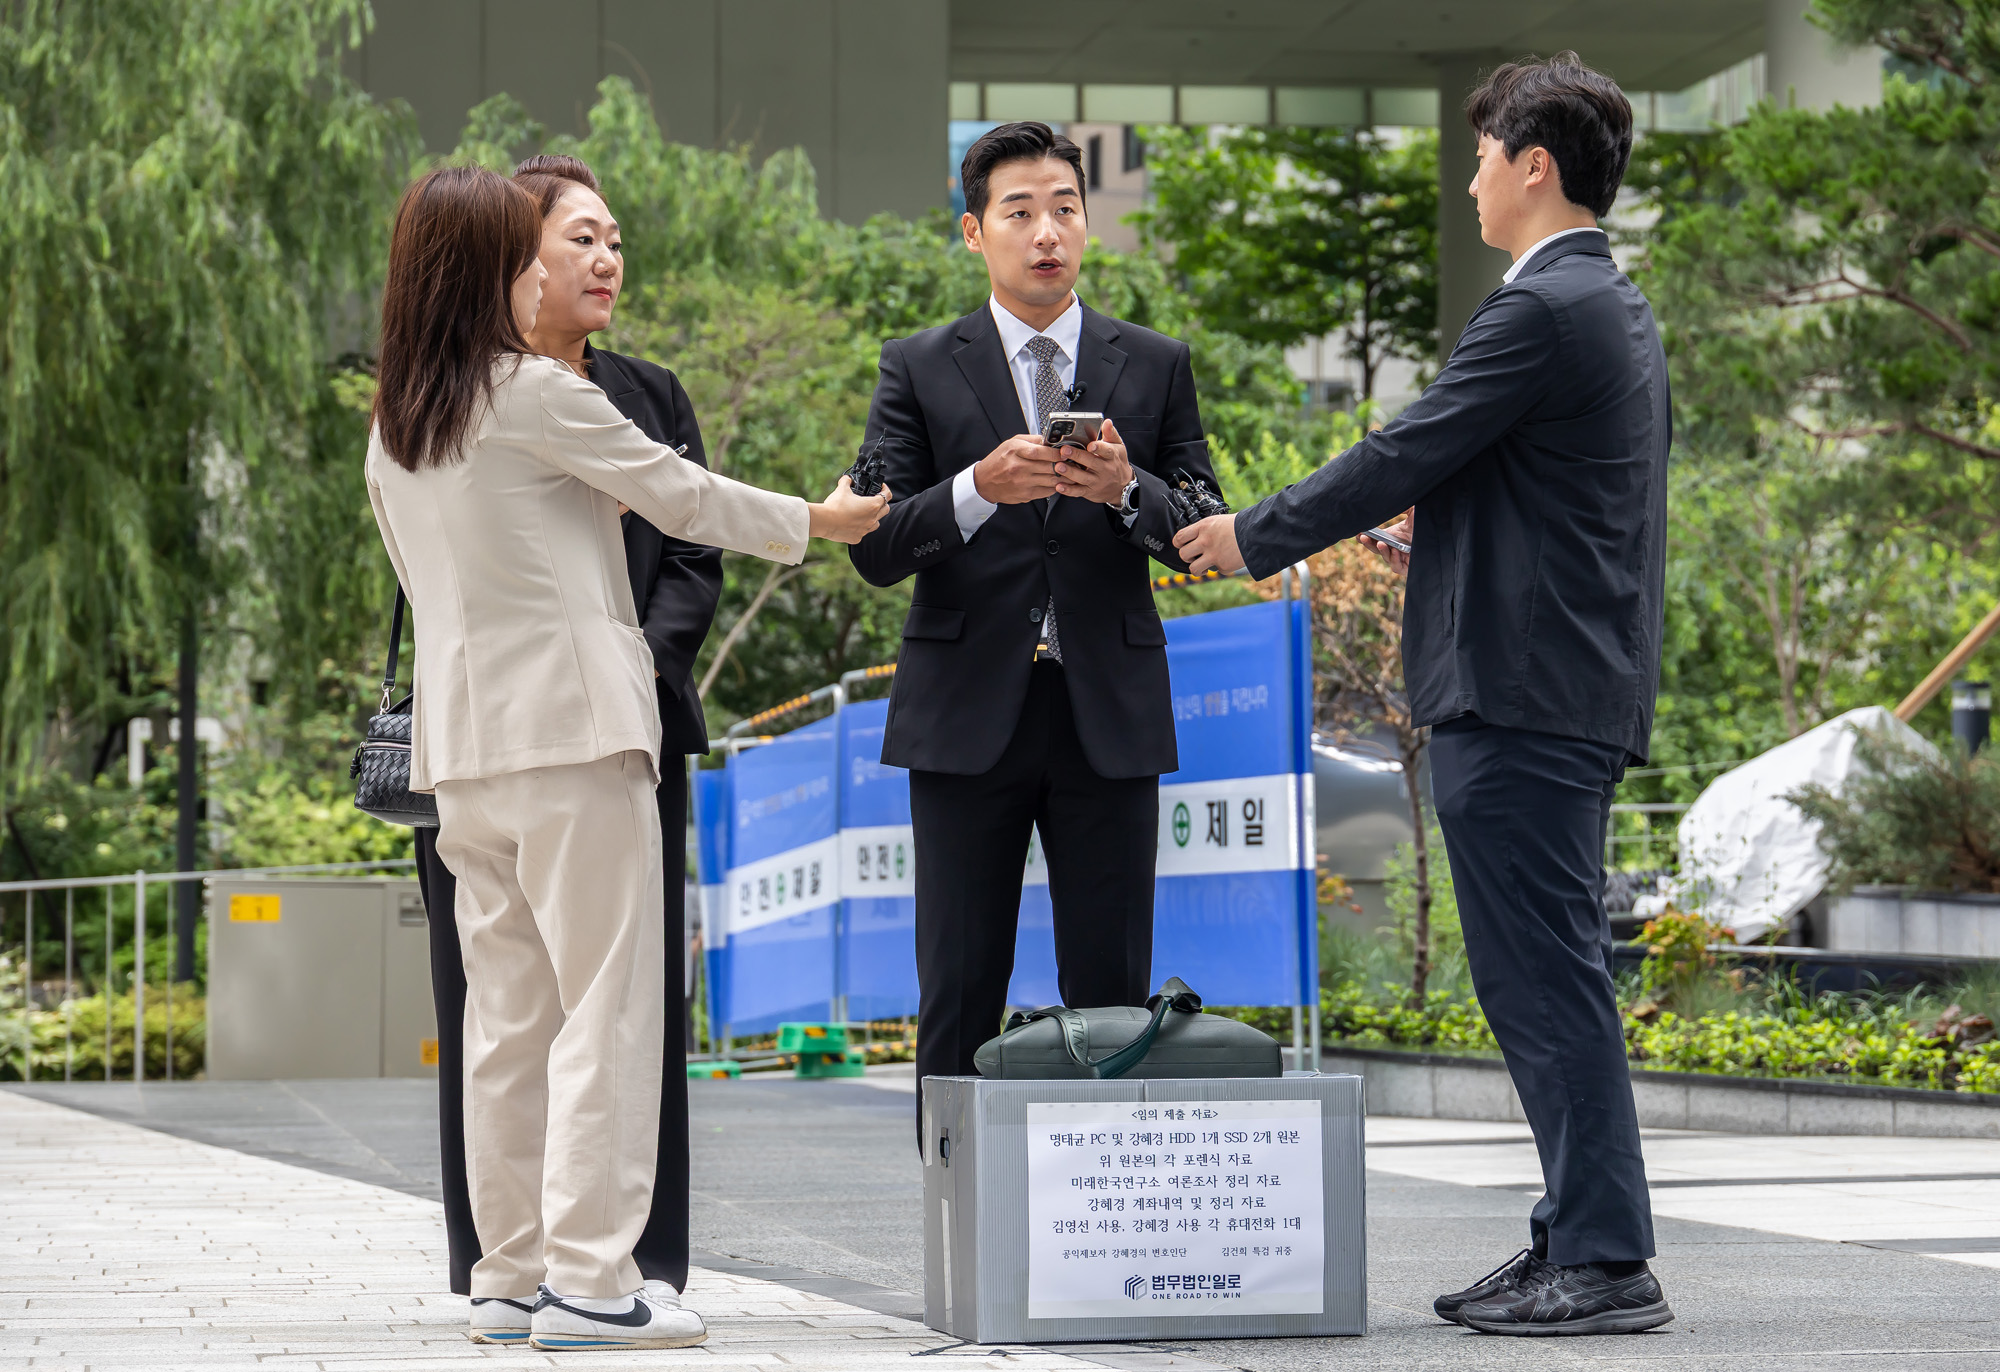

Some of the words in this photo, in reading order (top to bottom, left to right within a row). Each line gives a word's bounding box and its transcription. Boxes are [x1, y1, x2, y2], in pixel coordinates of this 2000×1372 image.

[1205, 797, 1264, 847] 제일
[857, 845, 889, 881] 안전
[1131, 1109, 1158, 1121] <임의
[1163, 1109, 1186, 1121] 제출
[1191, 1108, 1219, 1121] 자료>
[1049, 1132, 1086, 1147] 명태균
[1089, 1132, 1106, 1145] PC
[1111, 1132, 1124, 1146] 및
[1128, 1132, 1164, 1146] 강혜경
[1168, 1132, 1196, 1144] HDD
[1201, 1131, 1219, 1146] 1개
[1223, 1131, 1249, 1144] SSD
[1252, 1130, 1272, 1144] 2개
[1276, 1130, 1301, 1144] 원본
[1099, 1154, 1111, 1168] 위
[1118, 1153, 1156, 1168] 원본의
[1163, 1153, 1177, 1168] 각
[1182, 1152, 1220, 1167] 포렌식
[1227, 1152, 1254, 1166] 자료
[1071, 1175, 1161, 1191] 미래한국연구소
[1167, 1174, 1219, 1190] 여론조사
[1224, 1173, 1249, 1188] 정리
[1255, 1173, 1282, 1187] 자료
[1087, 1197, 1125, 1212] 강혜경
[1132, 1196, 1183, 1211] 계좌내역
[1190, 1196, 1203, 1211] 및
[1209, 1195, 1234, 1210] 정리
[1240, 1195, 1267, 1210] 자료
[1052, 1218, 1090, 1234] 김영선
[1095, 1218, 1125, 1234] 사용,
[1131, 1218, 1169, 1233] 강혜경
[1175, 1217, 1202, 1233] 사용
[1207, 1217, 1221, 1232] 각
[1226, 1216, 1277, 1231] 휴대전화
[1283, 1216, 1301, 1231] 1대
[1061, 1248, 1108, 1260] 공익제보자
[1111, 1248, 1147, 1259] 강혜경의
[1151, 1247, 1188, 1258] 변호인단
[1221, 1246, 1248, 1257] 김건희
[1251, 1246, 1270, 1257] 특검
[1274, 1245, 1293, 1257] 귀중
[1152, 1274, 1242, 1291] 법무법인일로
